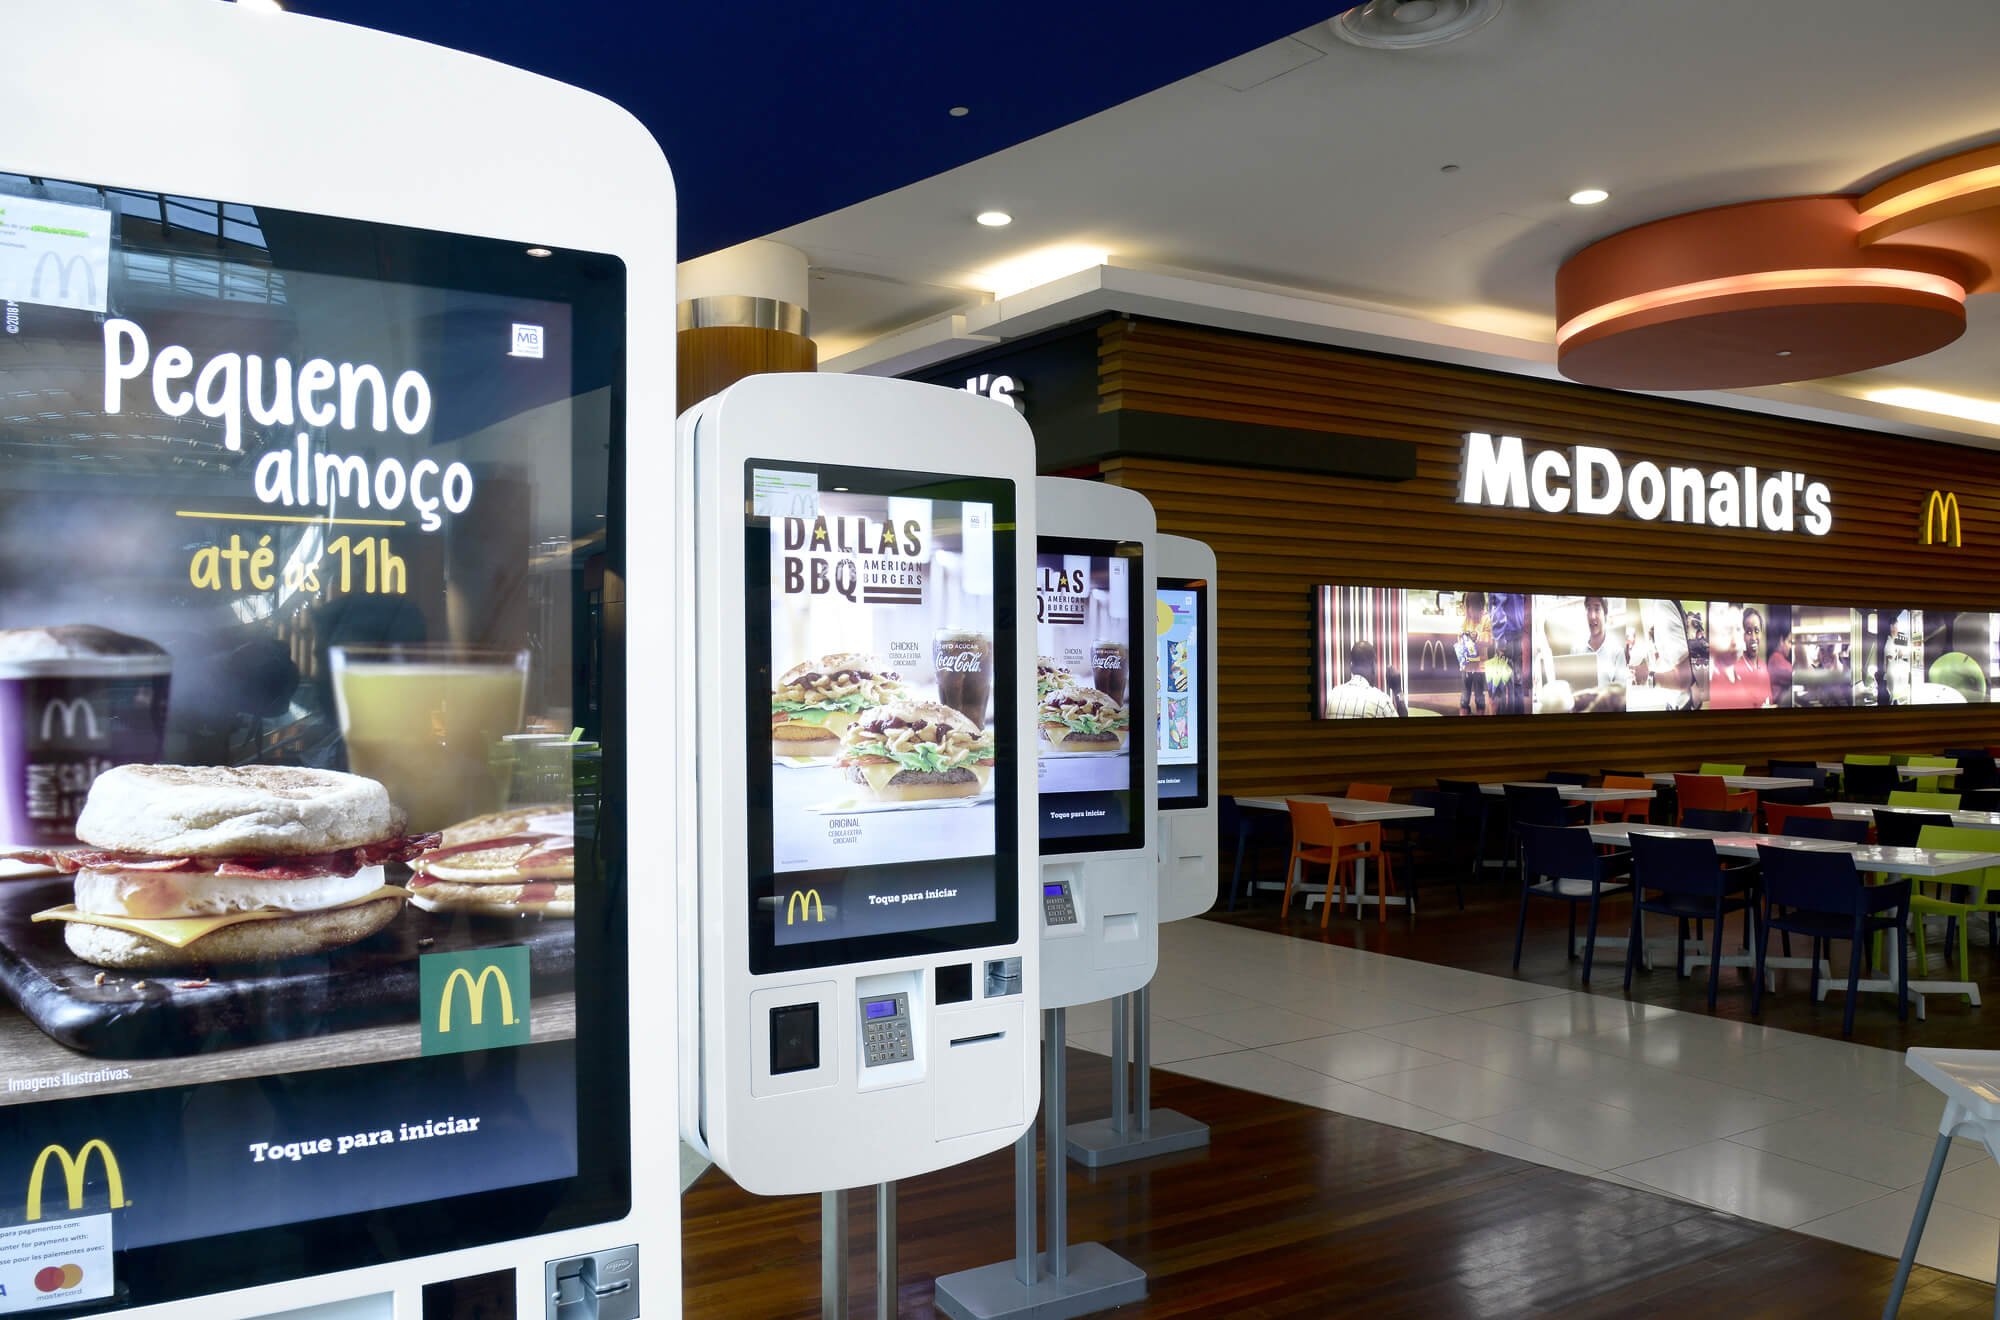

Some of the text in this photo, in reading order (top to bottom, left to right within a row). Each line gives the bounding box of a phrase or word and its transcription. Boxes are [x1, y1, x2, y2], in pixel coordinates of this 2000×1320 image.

[103, 317, 431, 451] Pequeno
[254, 432, 473, 532] almoço
[1460, 431, 1832, 536] McDonald's
[784, 515, 922, 557] DALLAS
[189, 534, 275, 591] até
[327, 535, 407, 594] 11h
[784, 556, 922, 603] BBQ AMERICAN
[863, 573, 922, 586] BURGERS
[890, 641, 919, 651] CHICKEN
[829, 818, 860, 829] ORIGINAL
[868, 888, 958, 905] Toque para iniciar
[8, 1074, 61, 1093] Imagens
[249, 1116, 481, 1162] Toque para iniciar
